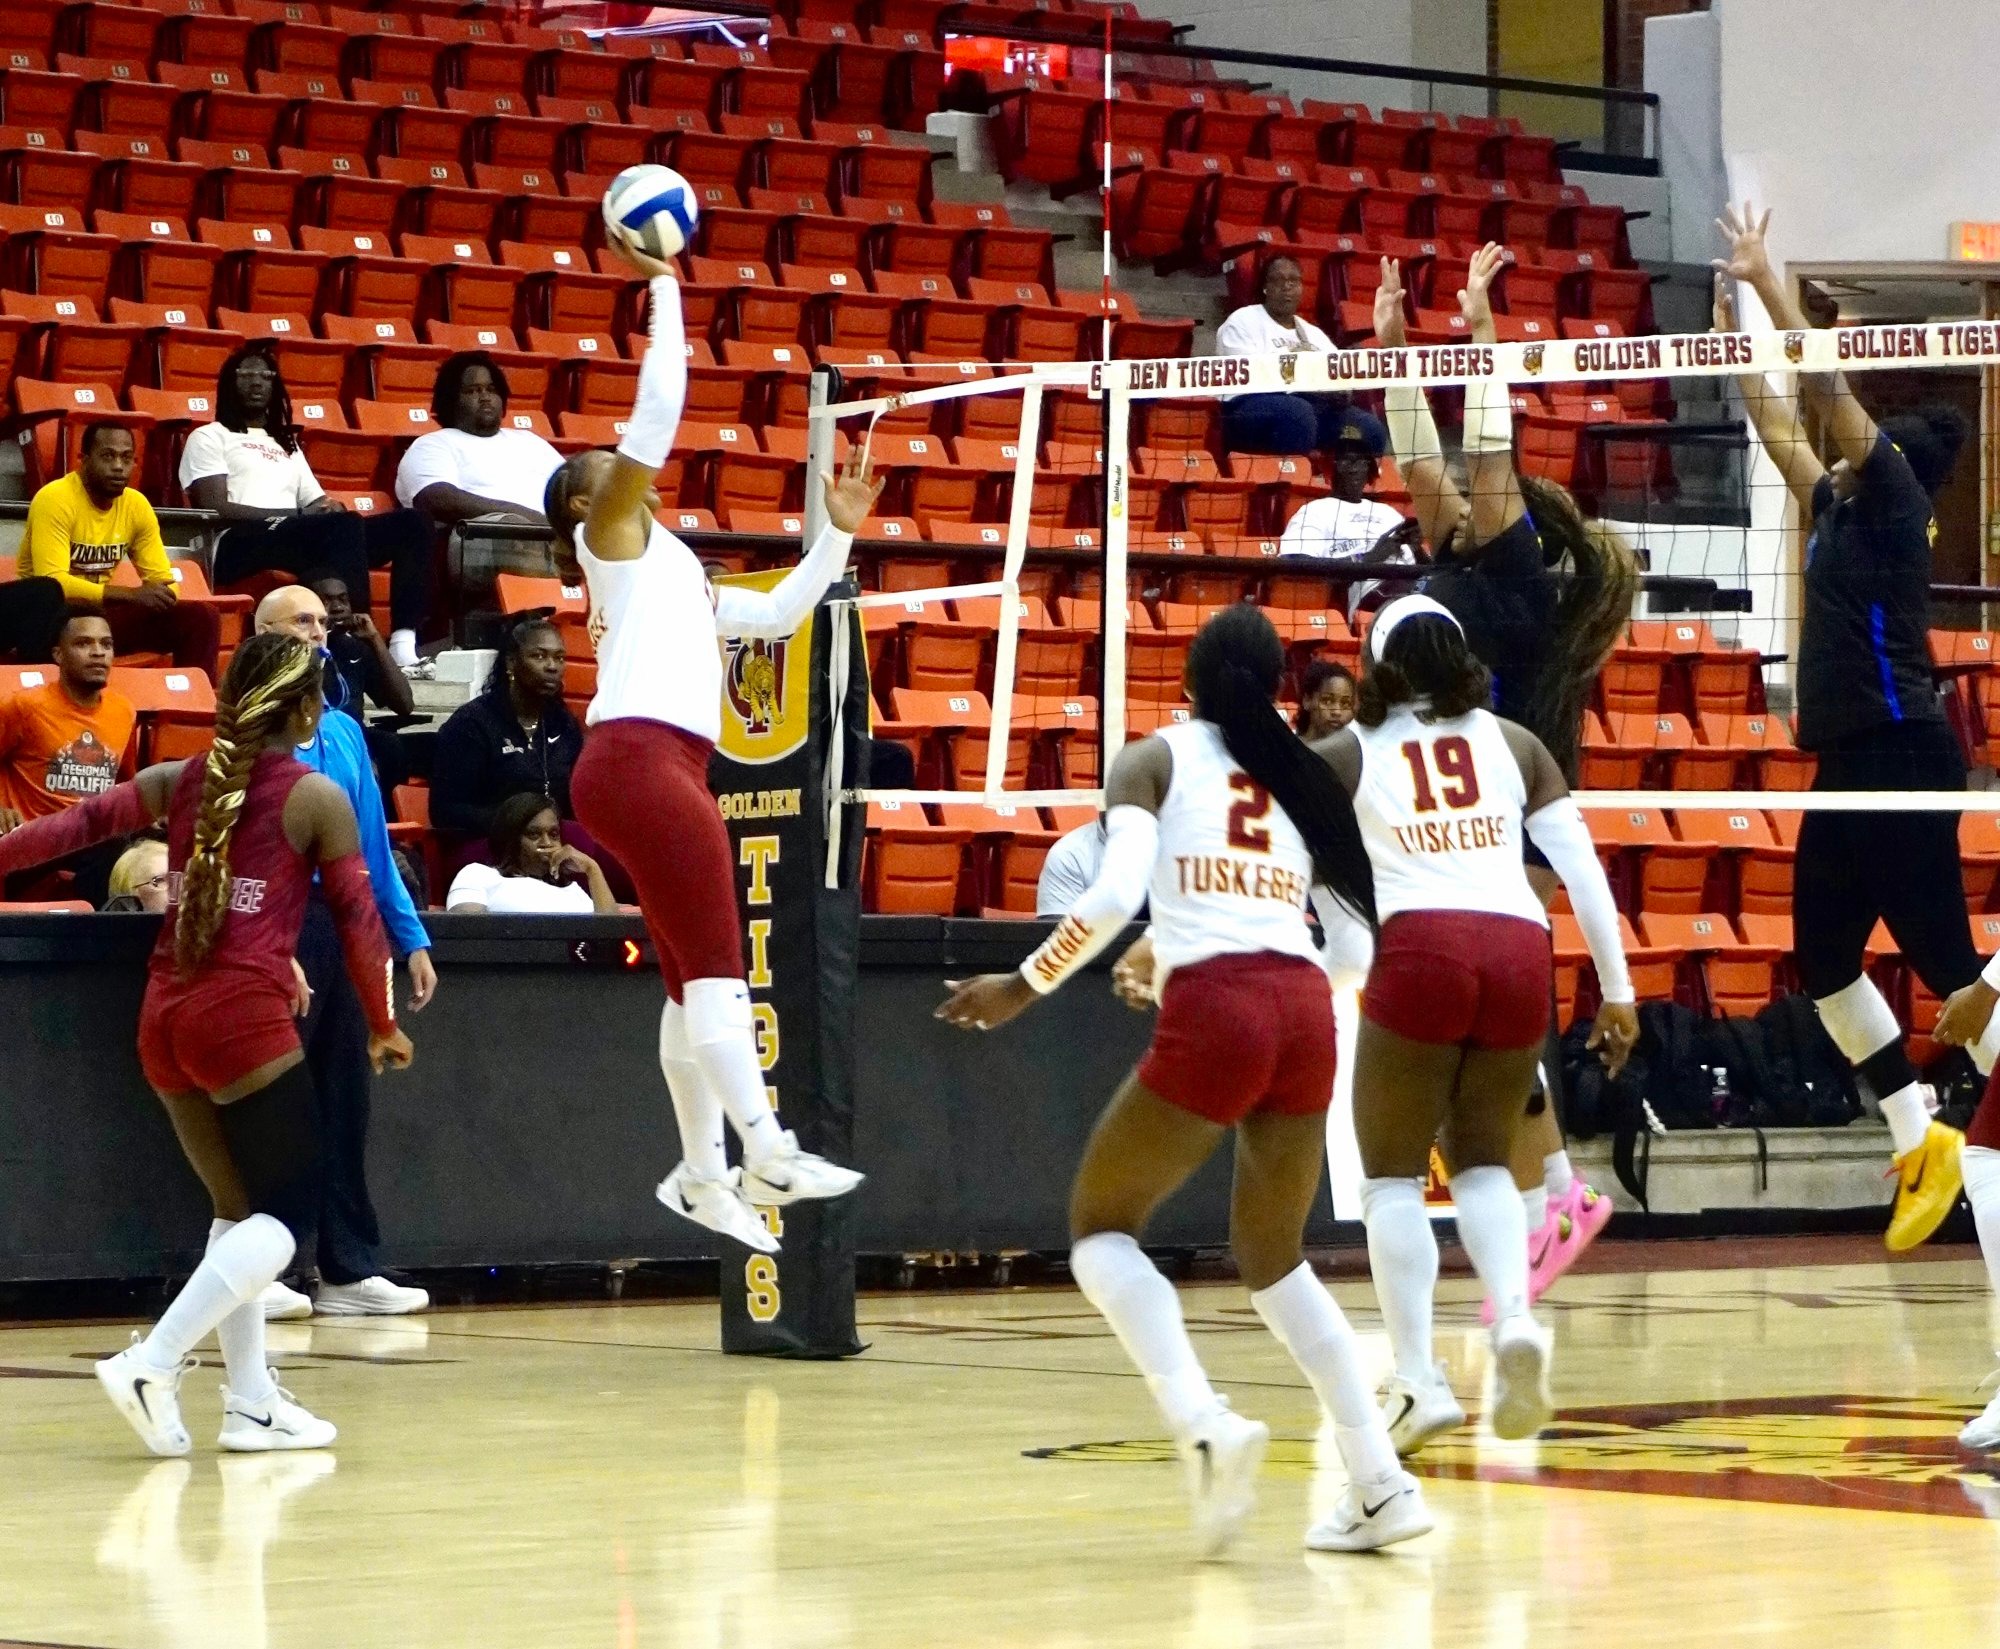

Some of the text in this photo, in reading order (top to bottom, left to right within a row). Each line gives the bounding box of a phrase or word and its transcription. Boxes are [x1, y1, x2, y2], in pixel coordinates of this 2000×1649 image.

[214, 74, 226, 83] 44
[31, 134, 41, 143] 41
[135, 143, 146, 153] 42
[336, 159, 347, 168] 44
[432, 168, 444, 177] 45
[60, 304, 72, 313] 39
[169, 313, 182, 322] 40
[276, 321, 286, 330] 41
[379, 326, 391, 335] 42
[1837, 327, 1928, 359] GOLDEN
[1574, 334, 1752, 372] GOLDEN TIGERS
[1327, 347, 1494, 380] GOLDEN TIGERS
[1091, 358, 1250, 391] GDEN TIGERS
[79, 391, 91, 400] 38
[193, 400, 204, 409] 39
[413, 411, 424, 419] 41
[518, 418, 529, 427] 42
[722, 430, 734, 439] 44
[912, 442, 924, 451] 46
[1004, 447, 1015, 456] 47
[359, 500, 370, 510] 39
[683, 517, 695, 526] 42
[886, 525, 898, 534] 44
[953, 699, 966, 710] 38
[1067, 705, 1080, 715] 39
[1174, 711, 1187, 722] 40
[1751, 723, 1763, 732] 46
[61, 763, 111, 778] REGIONAL
[1401, 735, 1482, 813] 19
[718, 788, 802, 820] GOLDEN
[1227, 769, 1272, 855] 2
[1632, 815, 1644, 824] 43
[1732, 817, 1745, 827] 44
[1696, 922, 1708, 932] 42
